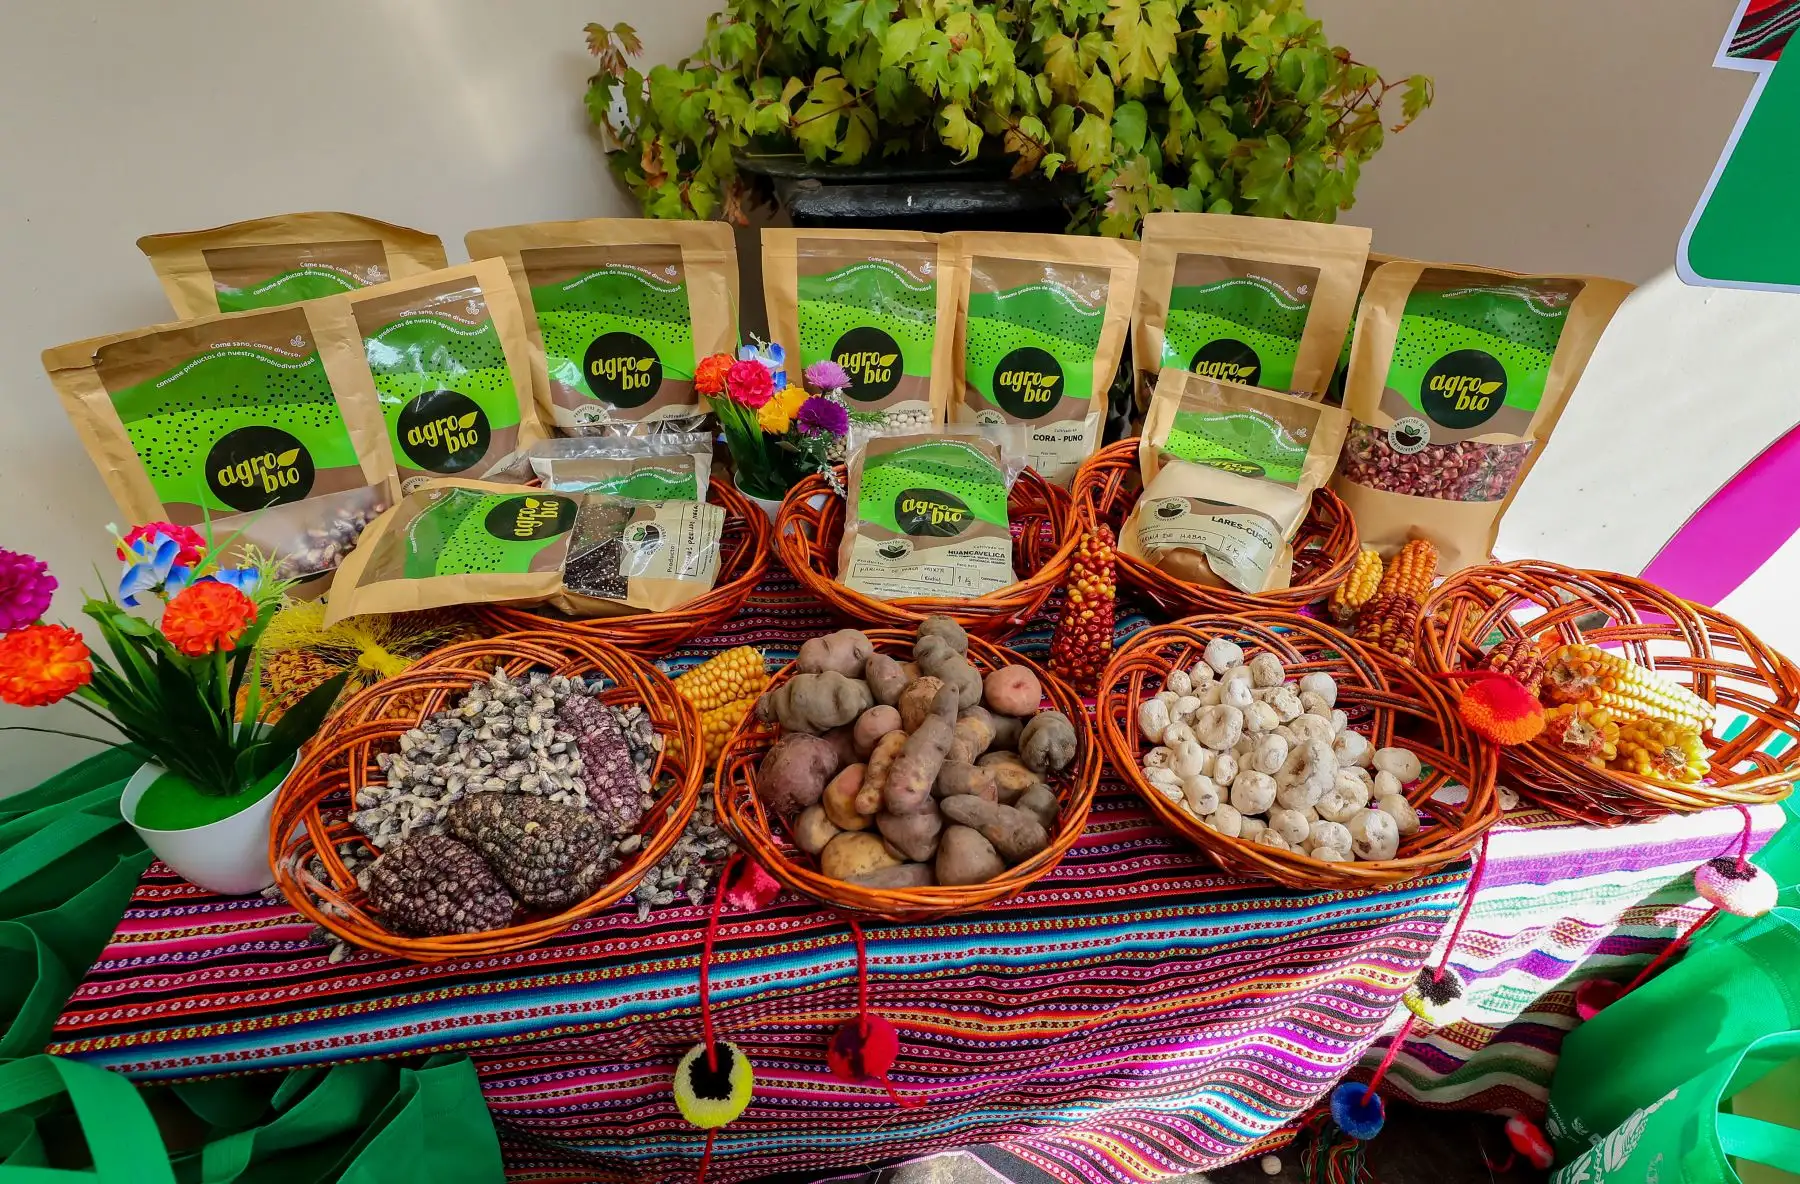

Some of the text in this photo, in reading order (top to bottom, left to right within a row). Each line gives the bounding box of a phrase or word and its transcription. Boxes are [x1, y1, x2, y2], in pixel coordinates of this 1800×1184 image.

[336, 266, 352, 276] come
[562, 279, 584, 292] consume
[583, 270, 609, 282] productos
[617, 271, 637, 279] nuestra
[637, 266, 652, 275] come
[1246, 272, 1260, 280] Come
[253, 283, 277, 296] consume
[277, 271, 303, 286] productos
[313, 271, 336, 280] nuestra
[1200, 285, 1221, 294] consume
[1221, 280, 1246, 289] productos
[400, 310, 417, 318] Come
[435, 310, 452, 318] come
[378, 322, 405, 340] productos
[438, 320, 489, 336] agrobiodiversidad
[210, 341, 231, 349] Come
[156, 370, 185, 389] consume
[184, 354, 216, 374] productos
[256, 354, 316, 369] agrobiodiversidad
[591, 356, 636, 381] agro
[837, 351, 879, 374] agro
[864, 361, 891, 384] bio
[622, 366, 650, 391] bio
[1000, 370, 1042, 392] agro
[1430, 374, 1481, 398] agro
[1023, 381, 1051, 403] bio
[1455, 386, 1490, 411] bio
[407, 415, 458, 447] agro
[444, 427, 478, 455] bio
[1063, 434, 1083, 442] PUNO
[217, 452, 278, 488] agro
[259, 463, 301, 494] bio
[529, 501, 559, 518] bio
[902, 497, 949, 515] agro
[931, 507, 962, 525] bio
[513, 508, 543, 537] agro
[1211, 516, 1273, 550] LARES-CUSCO
[948, 550, 1006, 559] HUANCAVELICA
